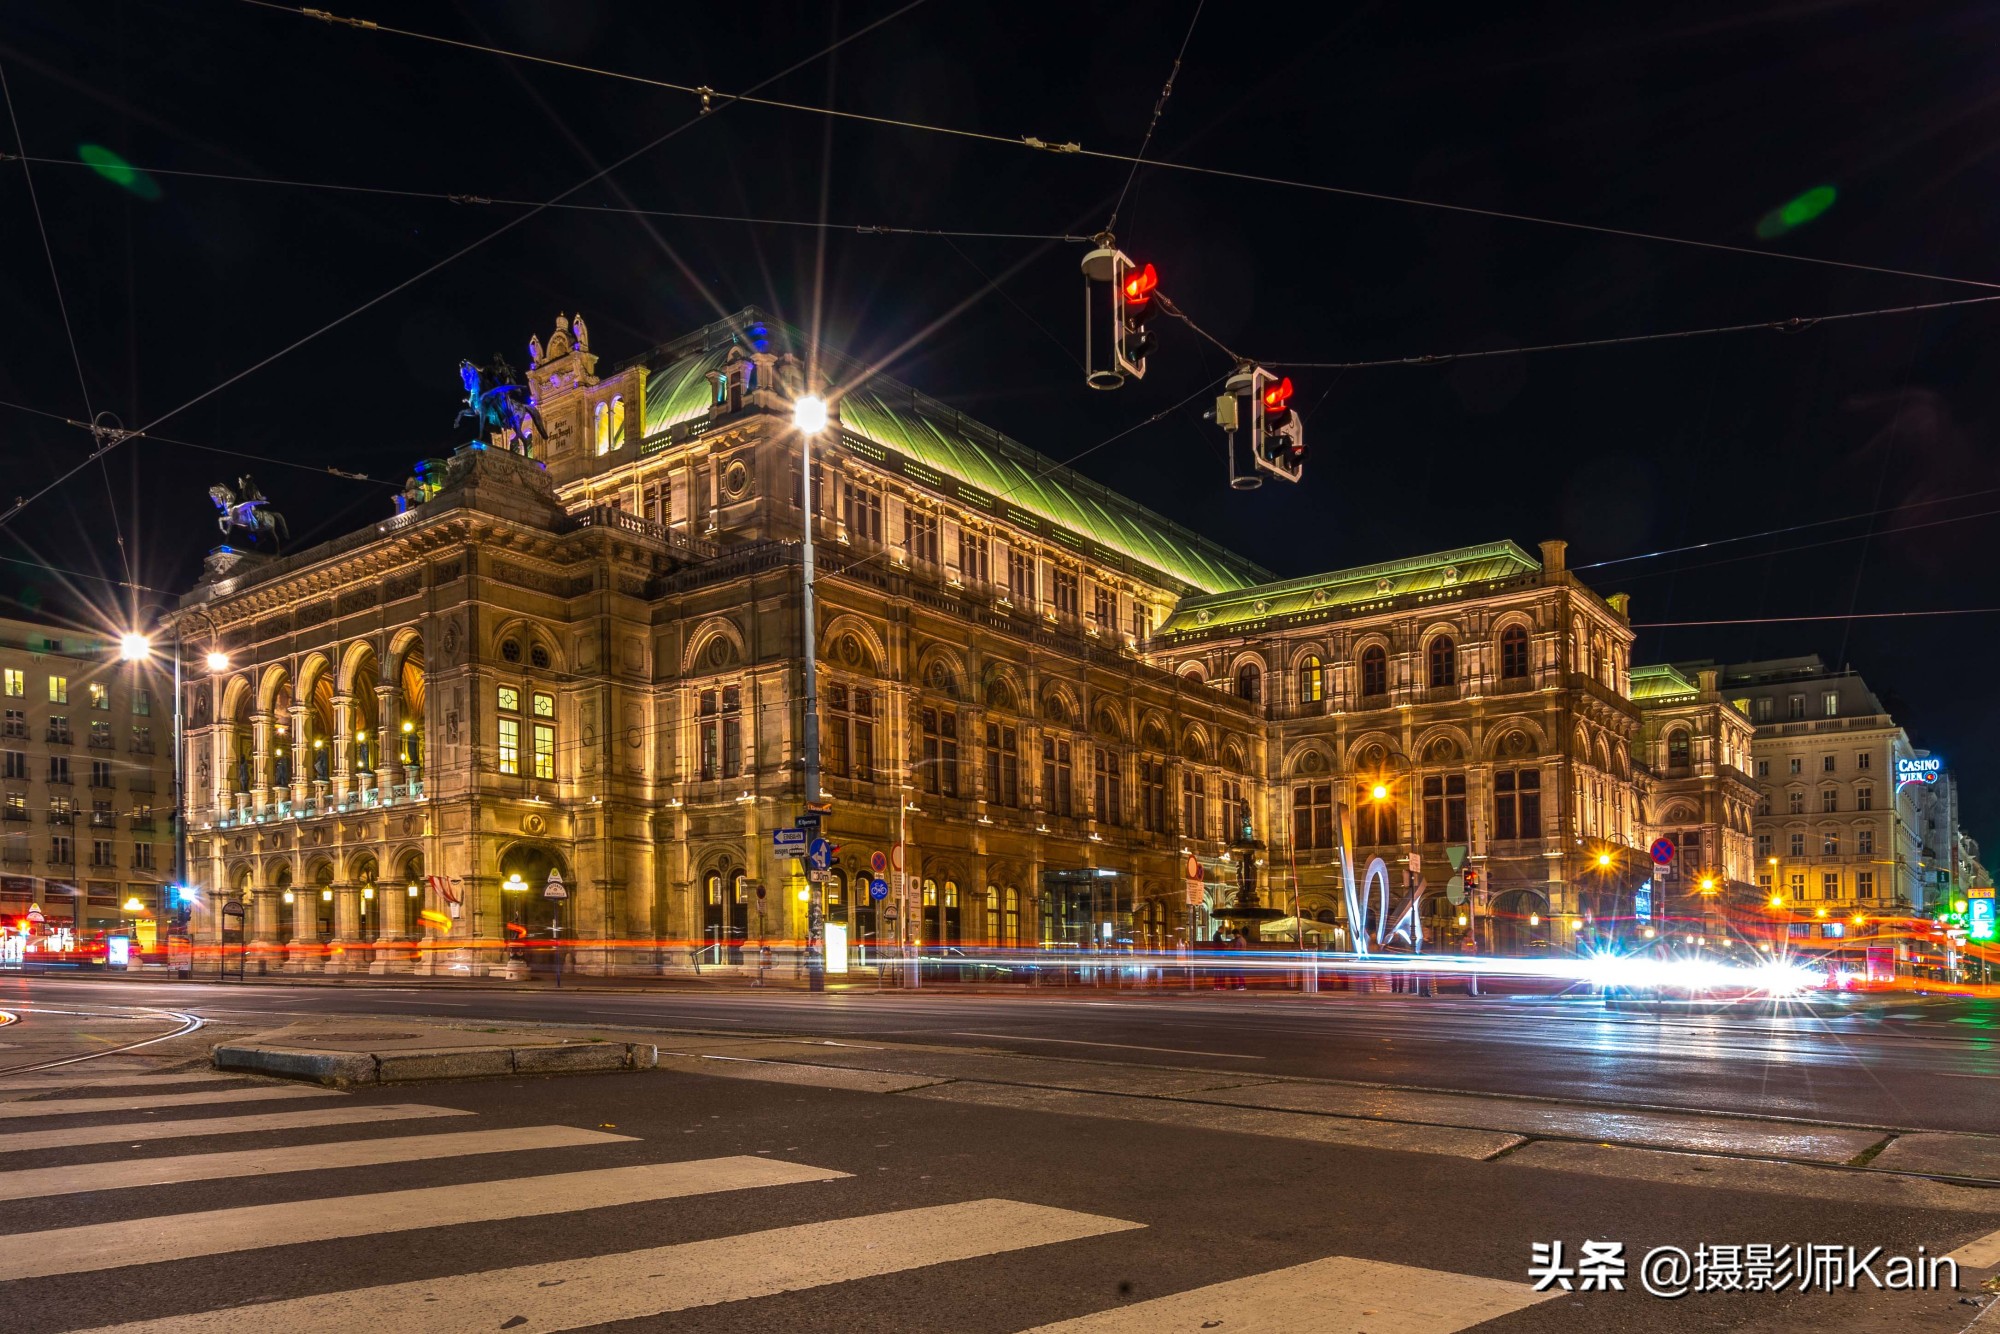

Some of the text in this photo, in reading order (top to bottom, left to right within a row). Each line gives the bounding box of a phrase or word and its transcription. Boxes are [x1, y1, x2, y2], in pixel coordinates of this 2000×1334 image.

[1899, 759, 1939, 772] CASINO
[1899, 772, 1923, 782] WIEN
[783, 833, 802, 841] EINBAHN
